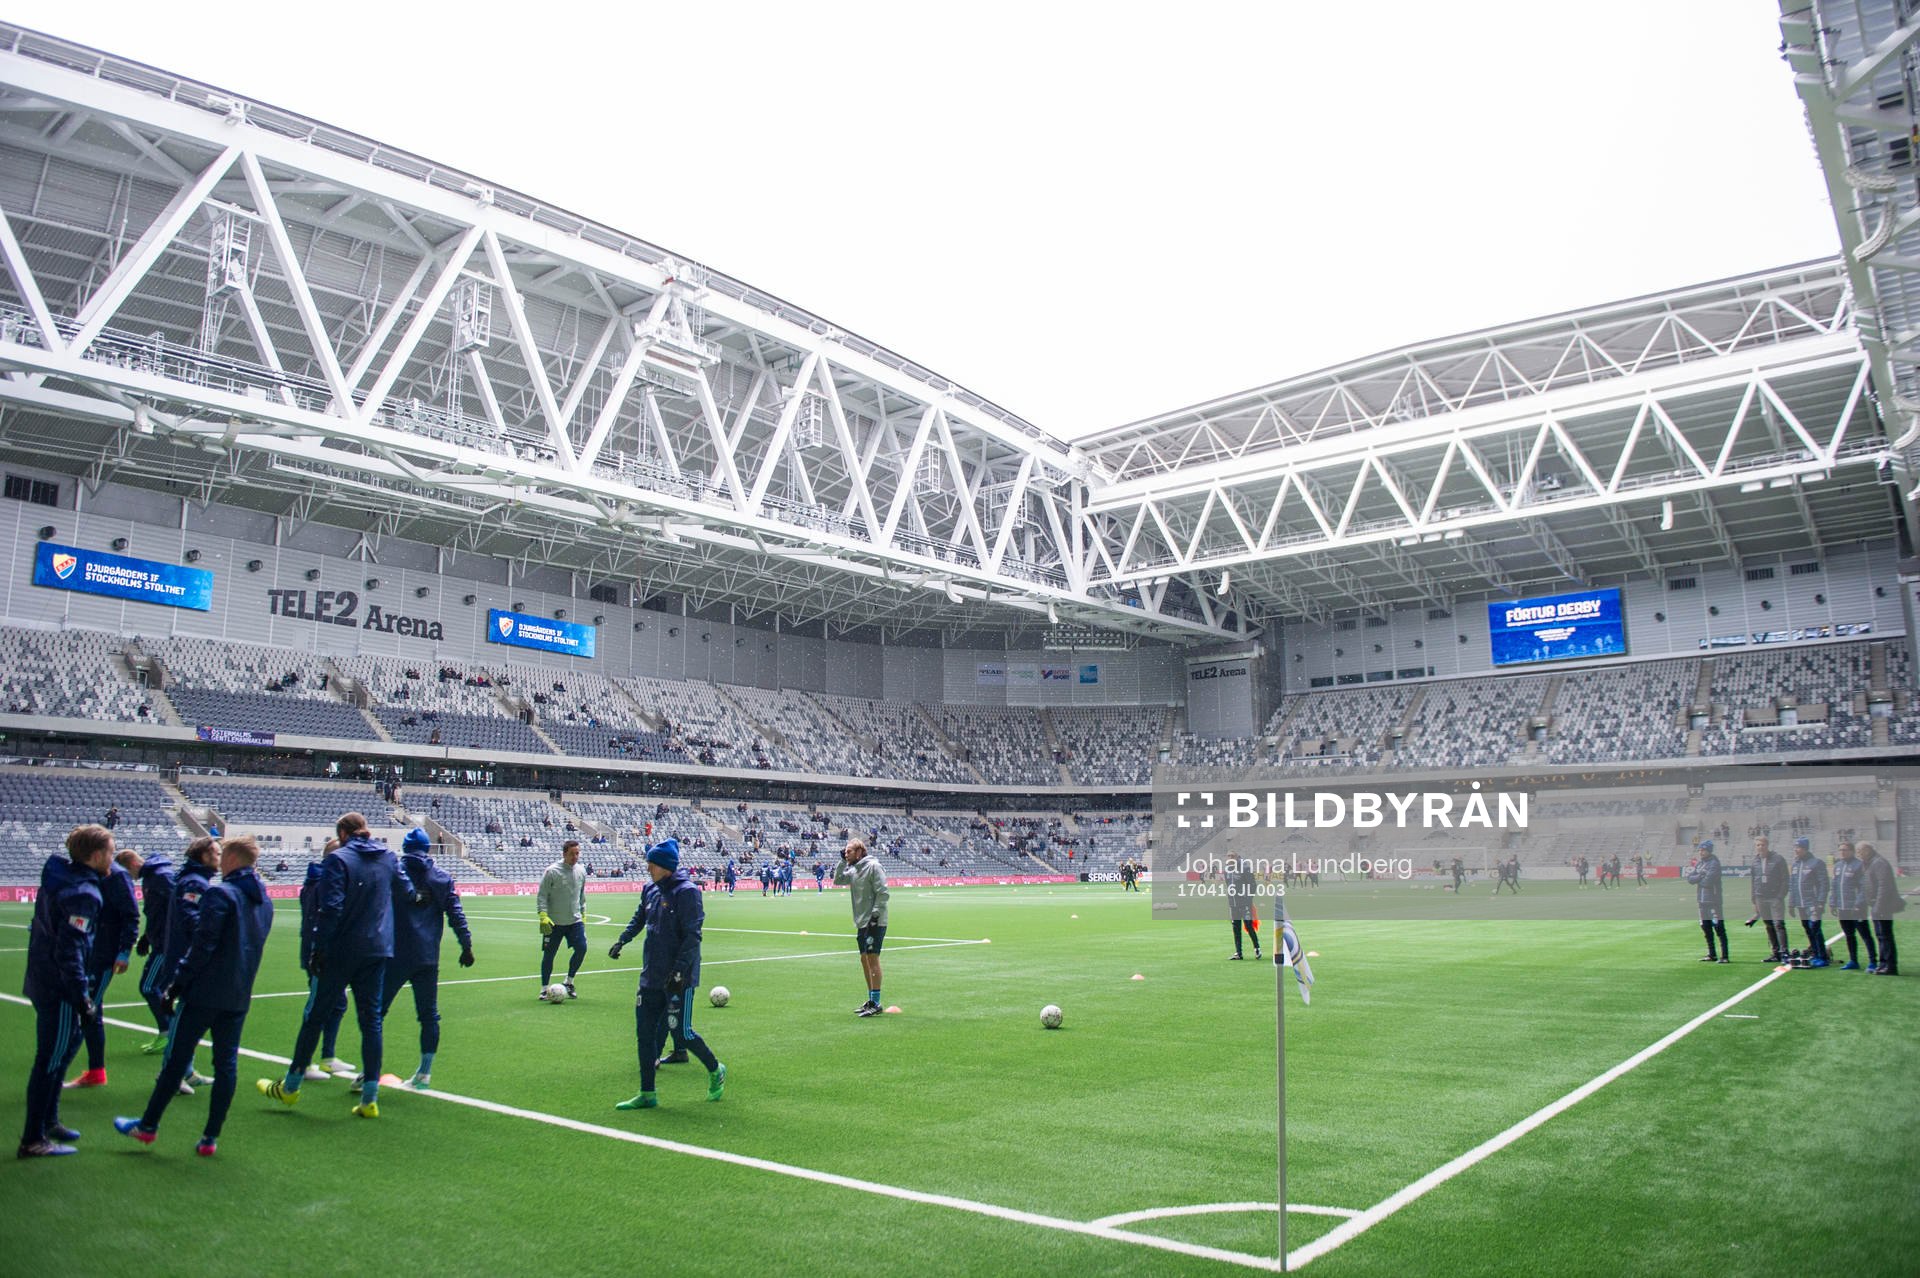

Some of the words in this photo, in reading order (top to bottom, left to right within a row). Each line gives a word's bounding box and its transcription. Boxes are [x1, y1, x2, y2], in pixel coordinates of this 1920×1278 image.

[86, 562, 148, 581] DJURGÅRDENS
[150, 574, 160, 582] IF
[85, 572, 142, 589] STOCKHOLMS
[144, 582, 186, 596] STOLTHET
[268, 589, 358, 627] TELE2
[363, 605, 444, 641] Arena
[1557, 599, 1601, 616] DERBY
[1191, 666, 1218, 680] TELE2
[1219, 668, 1247, 678] Arena
